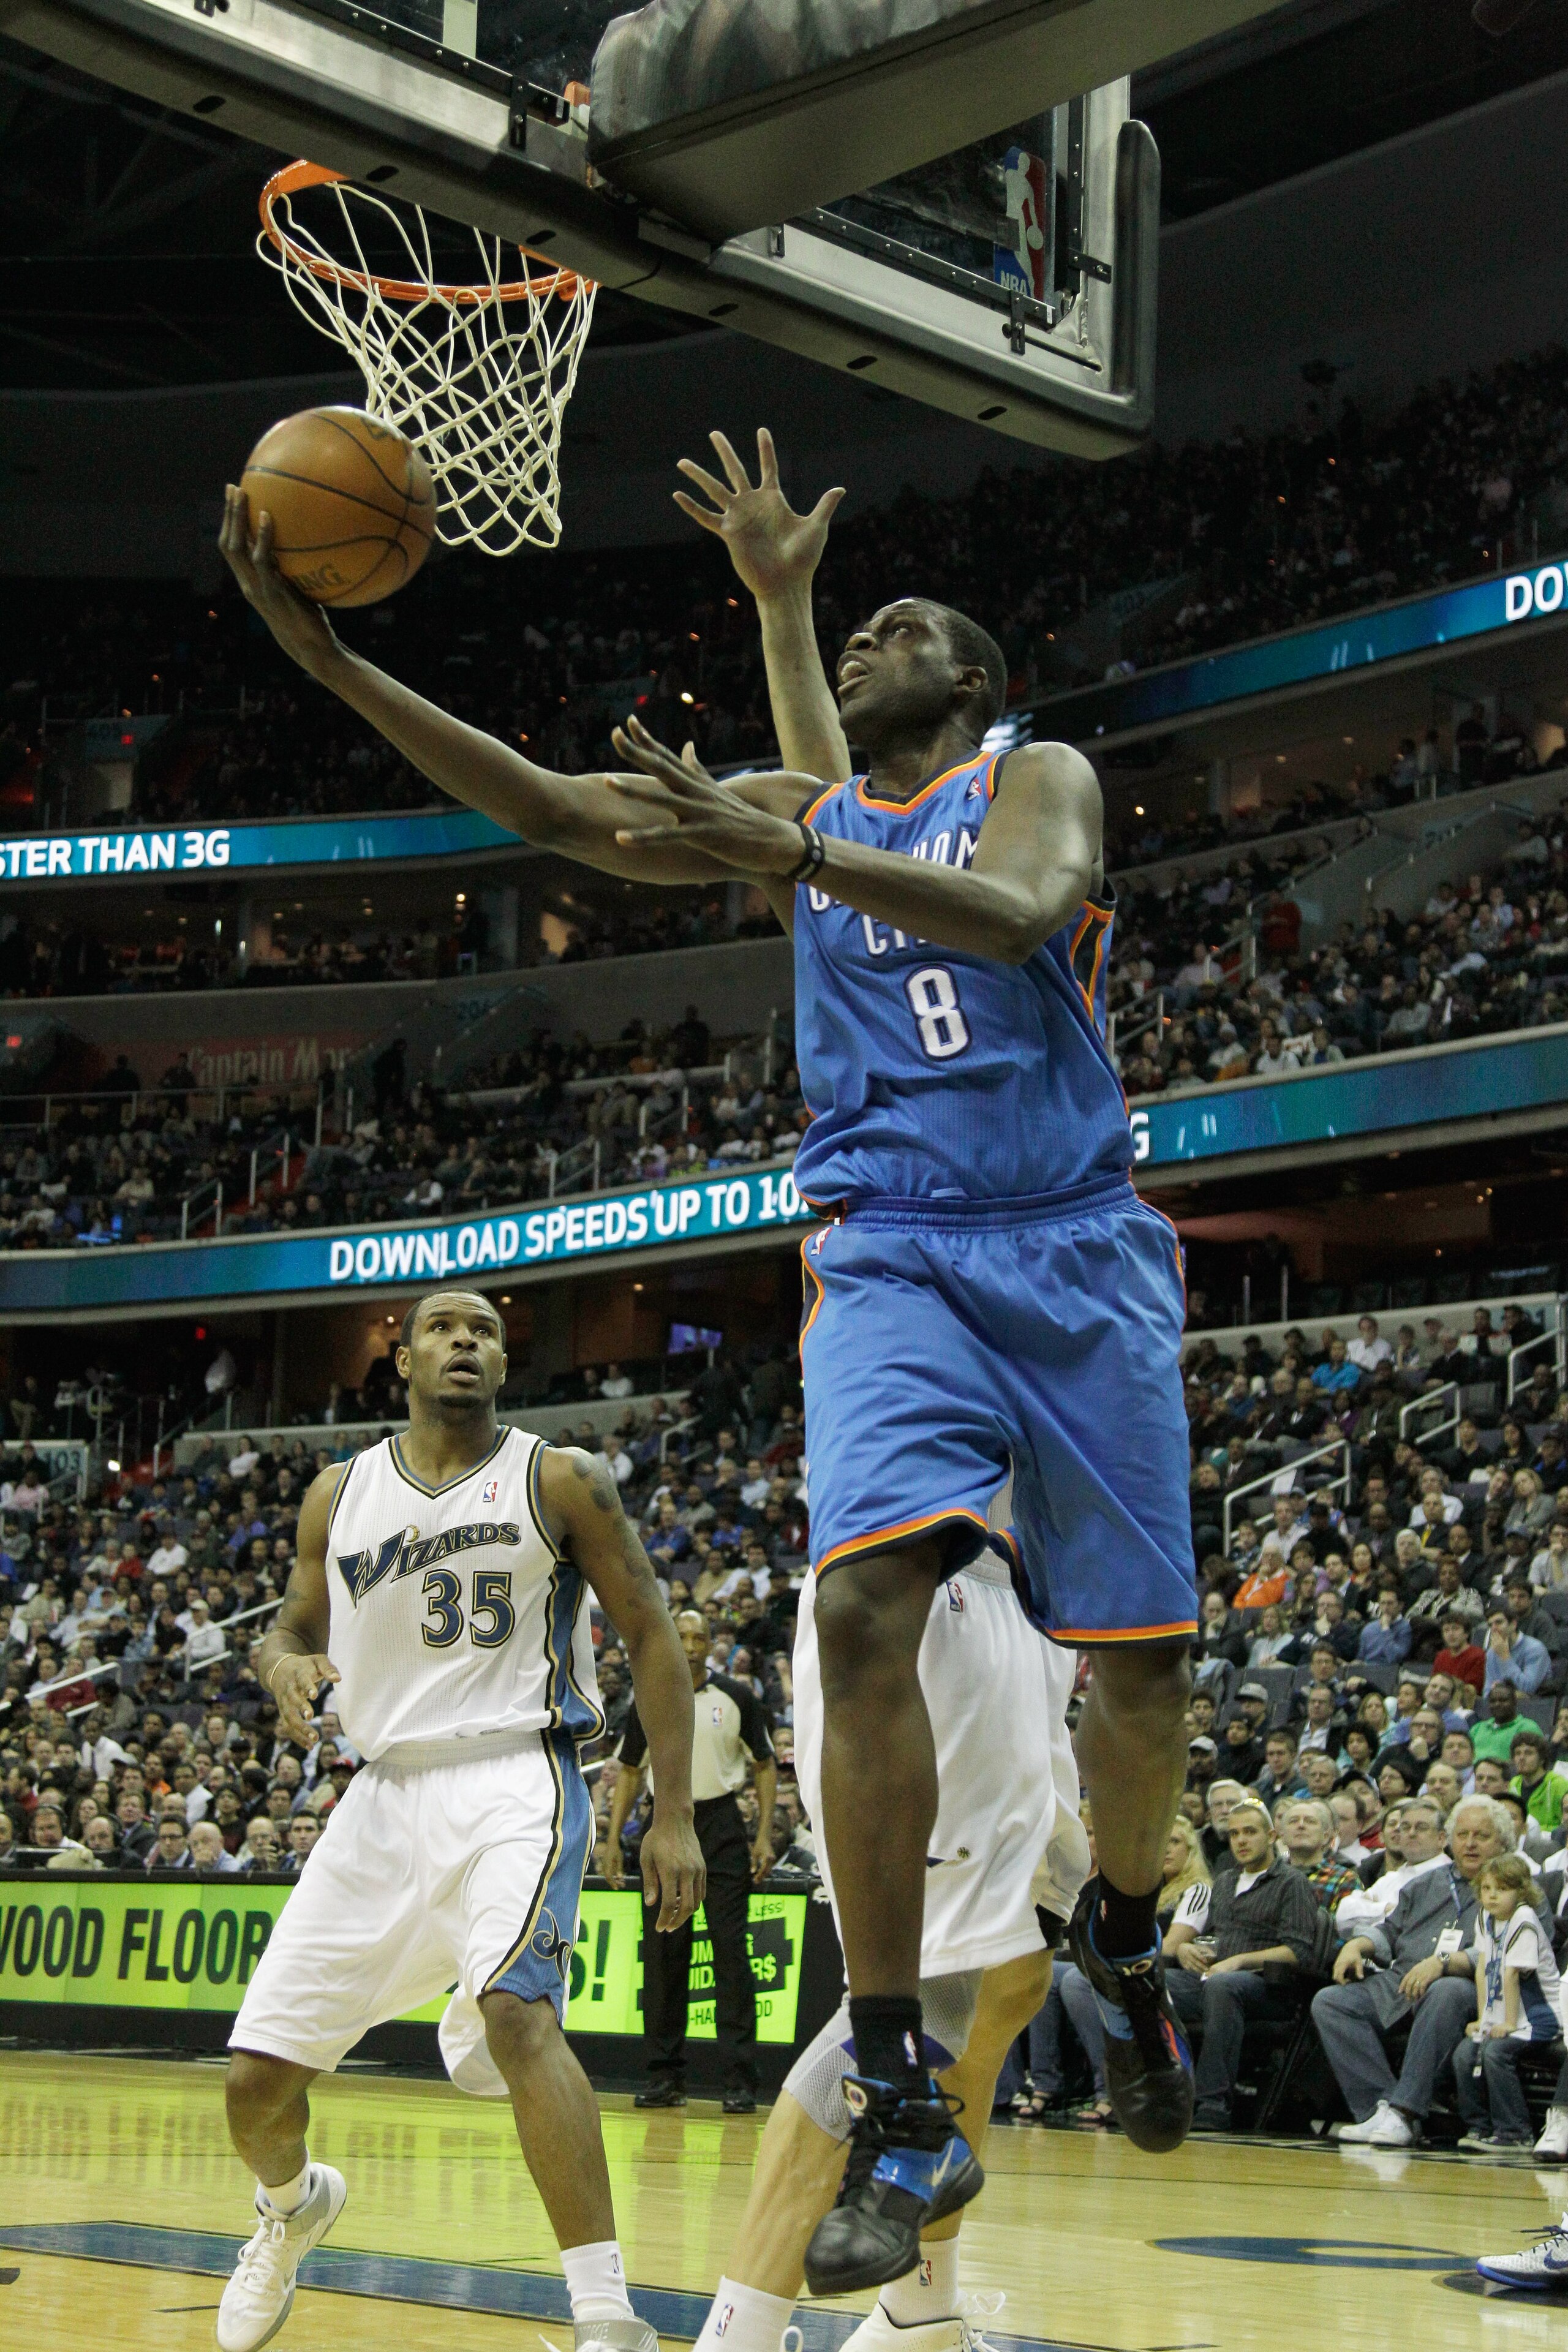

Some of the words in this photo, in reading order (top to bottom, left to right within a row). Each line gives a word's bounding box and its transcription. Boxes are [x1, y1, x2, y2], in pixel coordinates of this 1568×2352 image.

[1000, 270, 1028, 296] NBA
[1506, 562, 1568, 621] DO
[0, 838, 72, 876] TER
[78, 834, 176, 874] THAN
[181, 829, 230, 867] 3G
[904, 963, 971, 1061] 8
[330, 1220, 519, 1280] DOWNLOAD
[524, 1197, 648, 1257] SPEEDS
[654, 1189, 701, 1236] UP
[706, 1180, 750, 1227] TO
[758, 1172, 809, 1220] 10
[421, 1568, 516, 1648] 35
[118, 1909, 273, 1985] FLOOR
